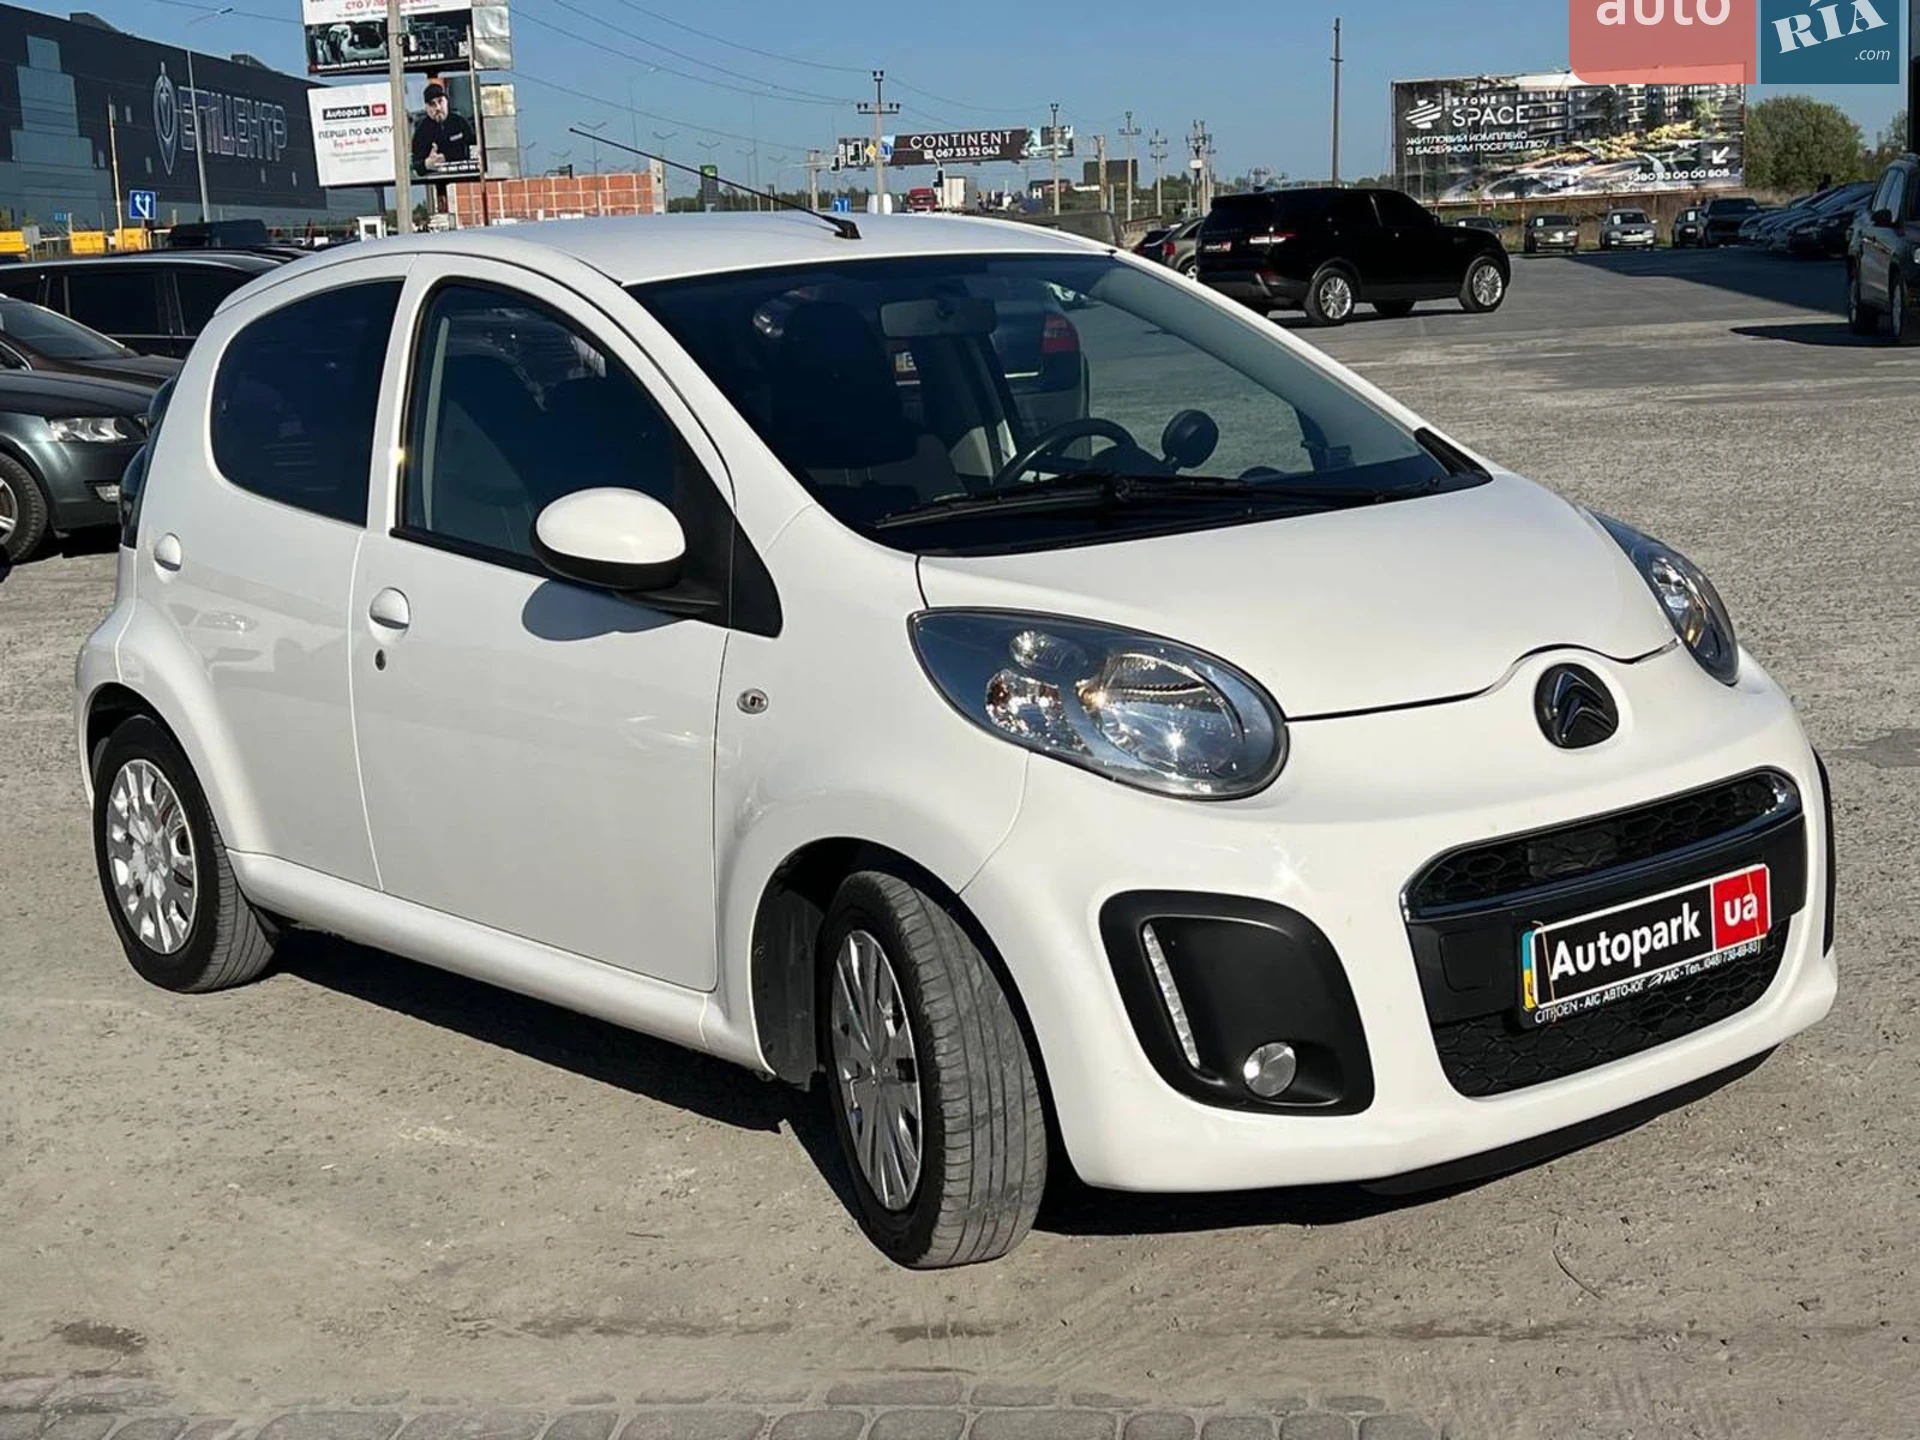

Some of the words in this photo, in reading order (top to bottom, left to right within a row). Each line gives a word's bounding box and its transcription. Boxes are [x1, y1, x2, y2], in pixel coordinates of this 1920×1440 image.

[1453, 96, 1496, 106] STONE
[326, 106, 368, 119] Autopark
[1452, 105, 1530, 126] SPACE
[349, 128, 362, 137] ПО
[910, 132, 1012, 150] CONTINENT
[935, 148, 954, 158] 067
[1551, 902, 1701, 981] Autopark
[1723, 892, 1758, 927] ua
